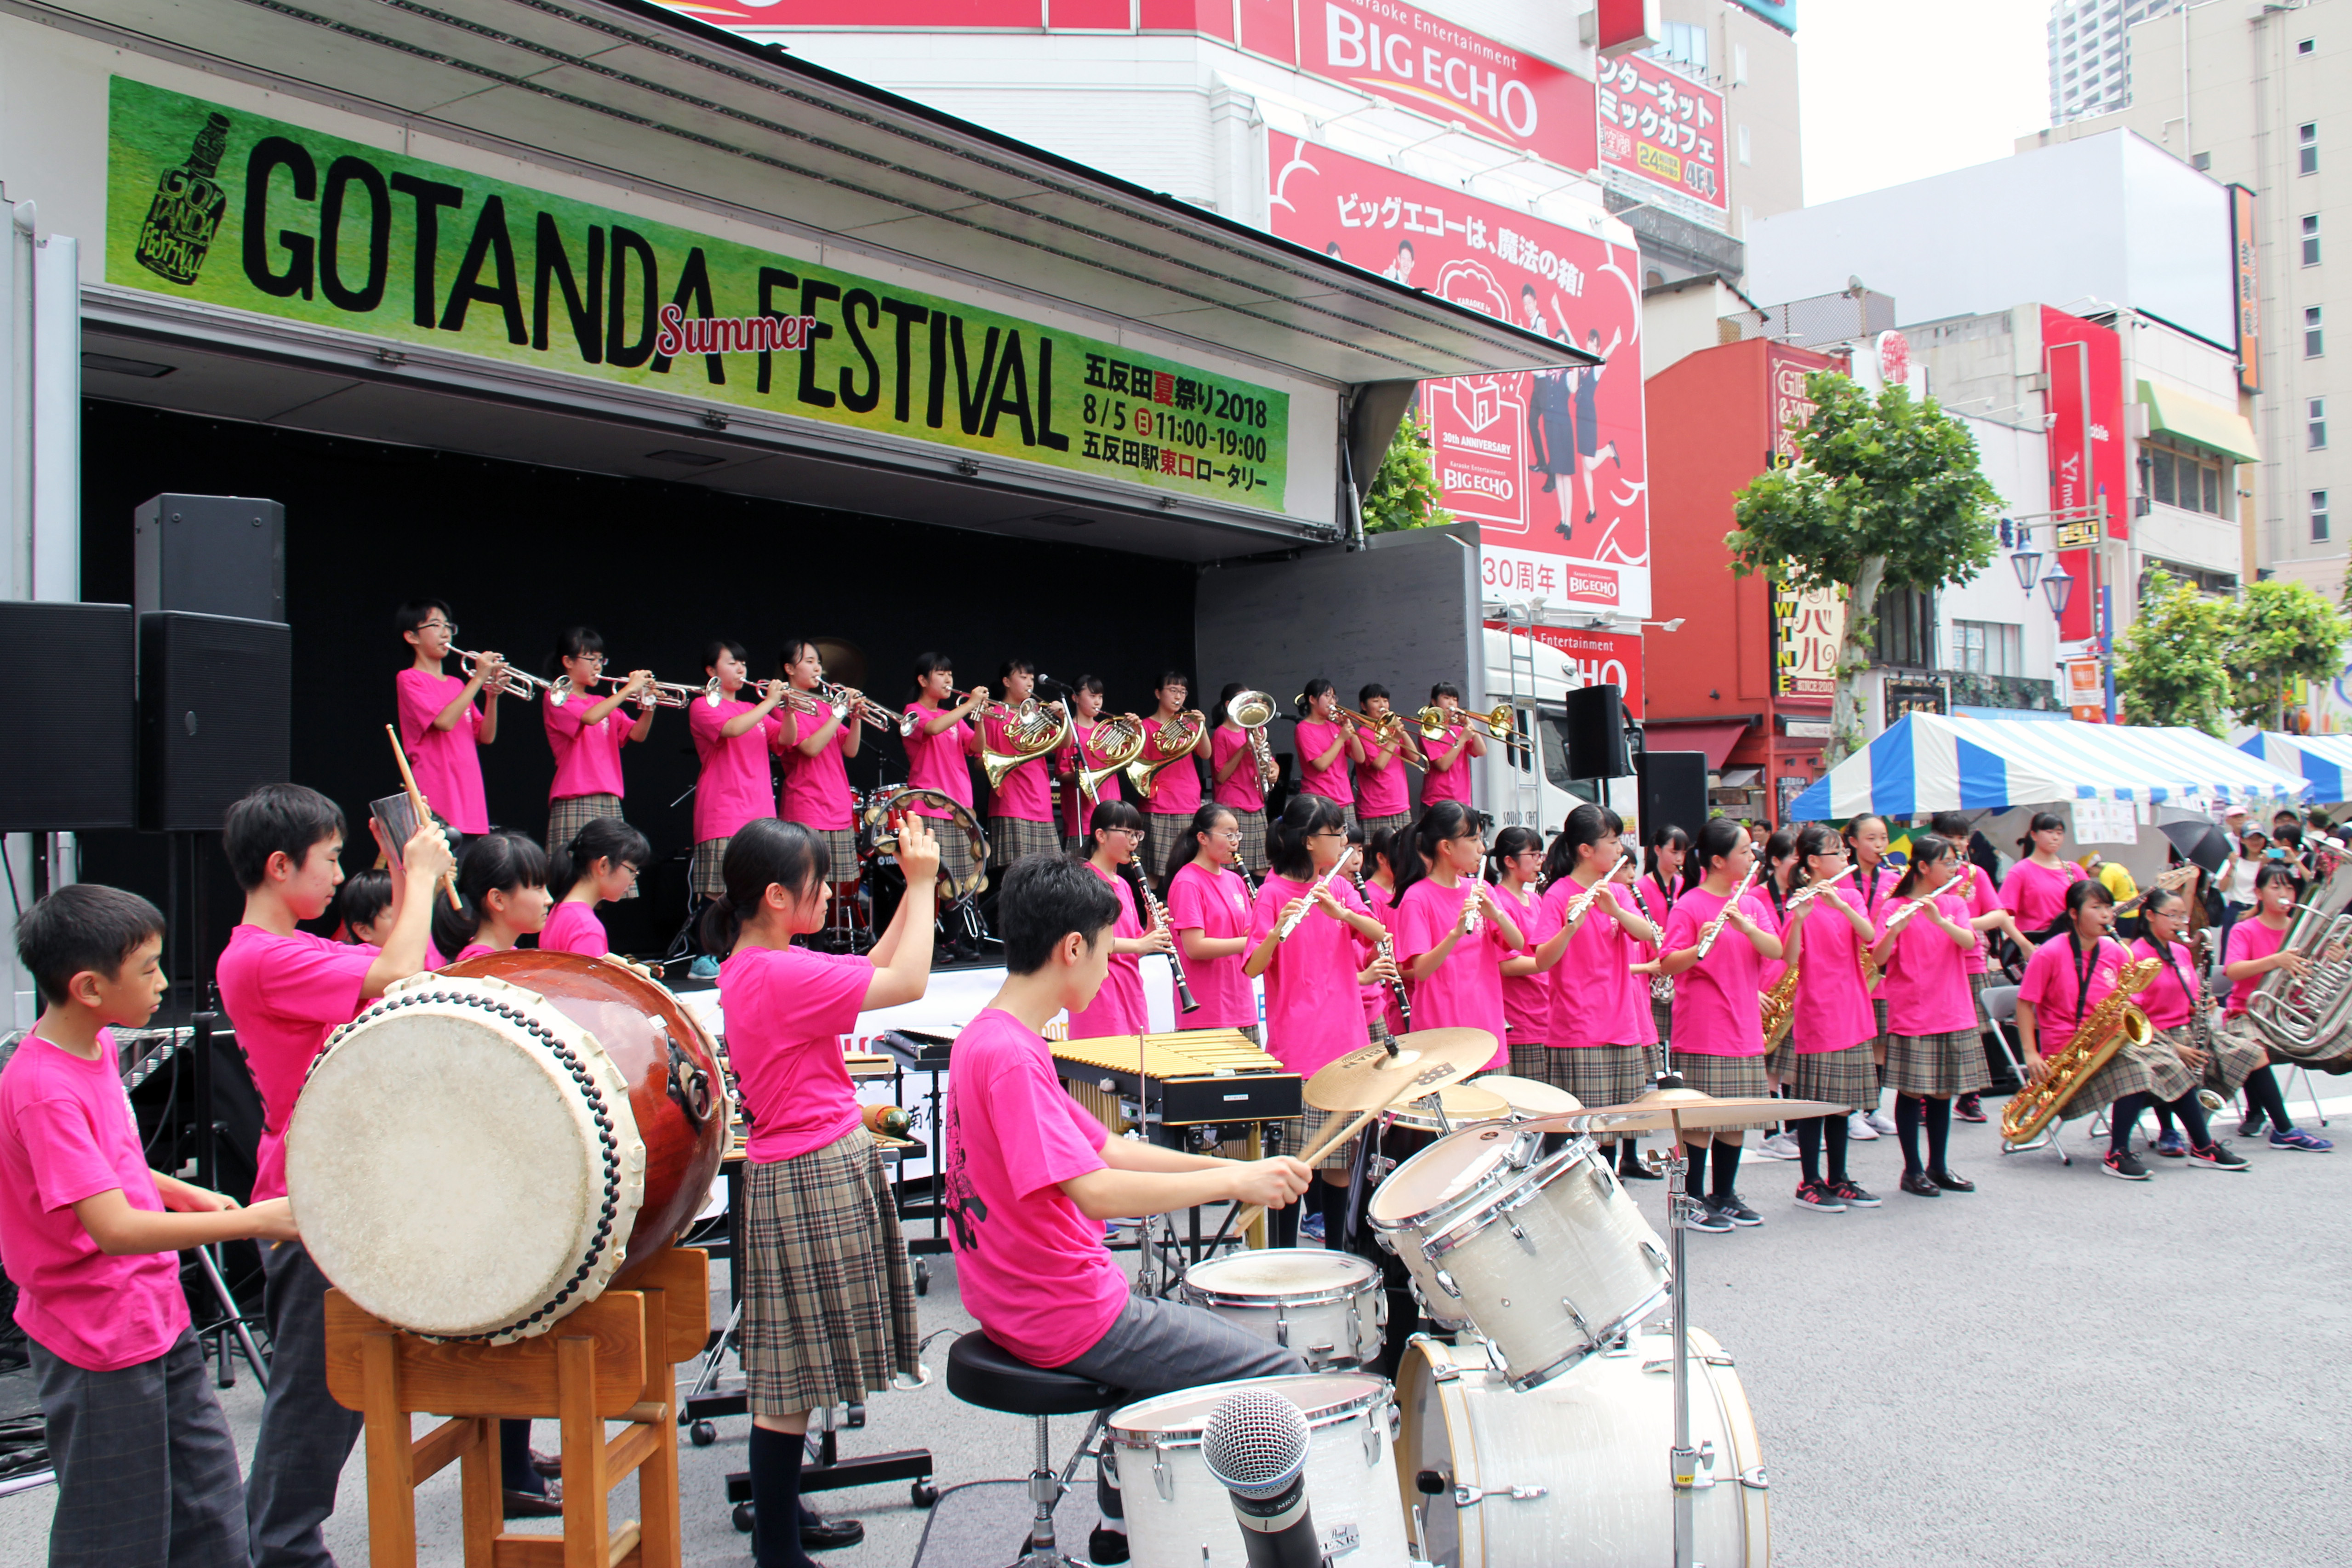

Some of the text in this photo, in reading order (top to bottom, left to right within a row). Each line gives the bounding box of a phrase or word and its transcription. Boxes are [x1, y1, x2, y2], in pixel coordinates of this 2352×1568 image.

[1350, 0, 1517, 71] araoke Entertainment
[1326, 1, 1538, 137] BIG ECHO
[1598, 56, 1714, 128] ンターネット
[1600, 88, 1716, 165] ミックカフェ
[242, 136, 1069, 452] GOTANDA FESTIVAL
[1457, 297, 1491, 314] KARAOKE is
[657, 303, 816, 357] Summer
[1082, 429, 1267, 491] 五反田駅東口ロータリー
[1443, 431, 1512, 456] 30th ANNIVERSARY
[1444, 468, 1513, 500] BIG ECHO
[1450, 461, 1507, 477] Karaoke Entertainment
[1482, 557, 1556, 594] 30周年
[1570, 576, 1617, 598] BIG ECHO
[1541, 633, 1614, 652] Entertainment
[1793, 589, 1838, 672] バル
[1578, 658, 1628, 700] HO
[1277, 1494, 1296, 1510] MRD
